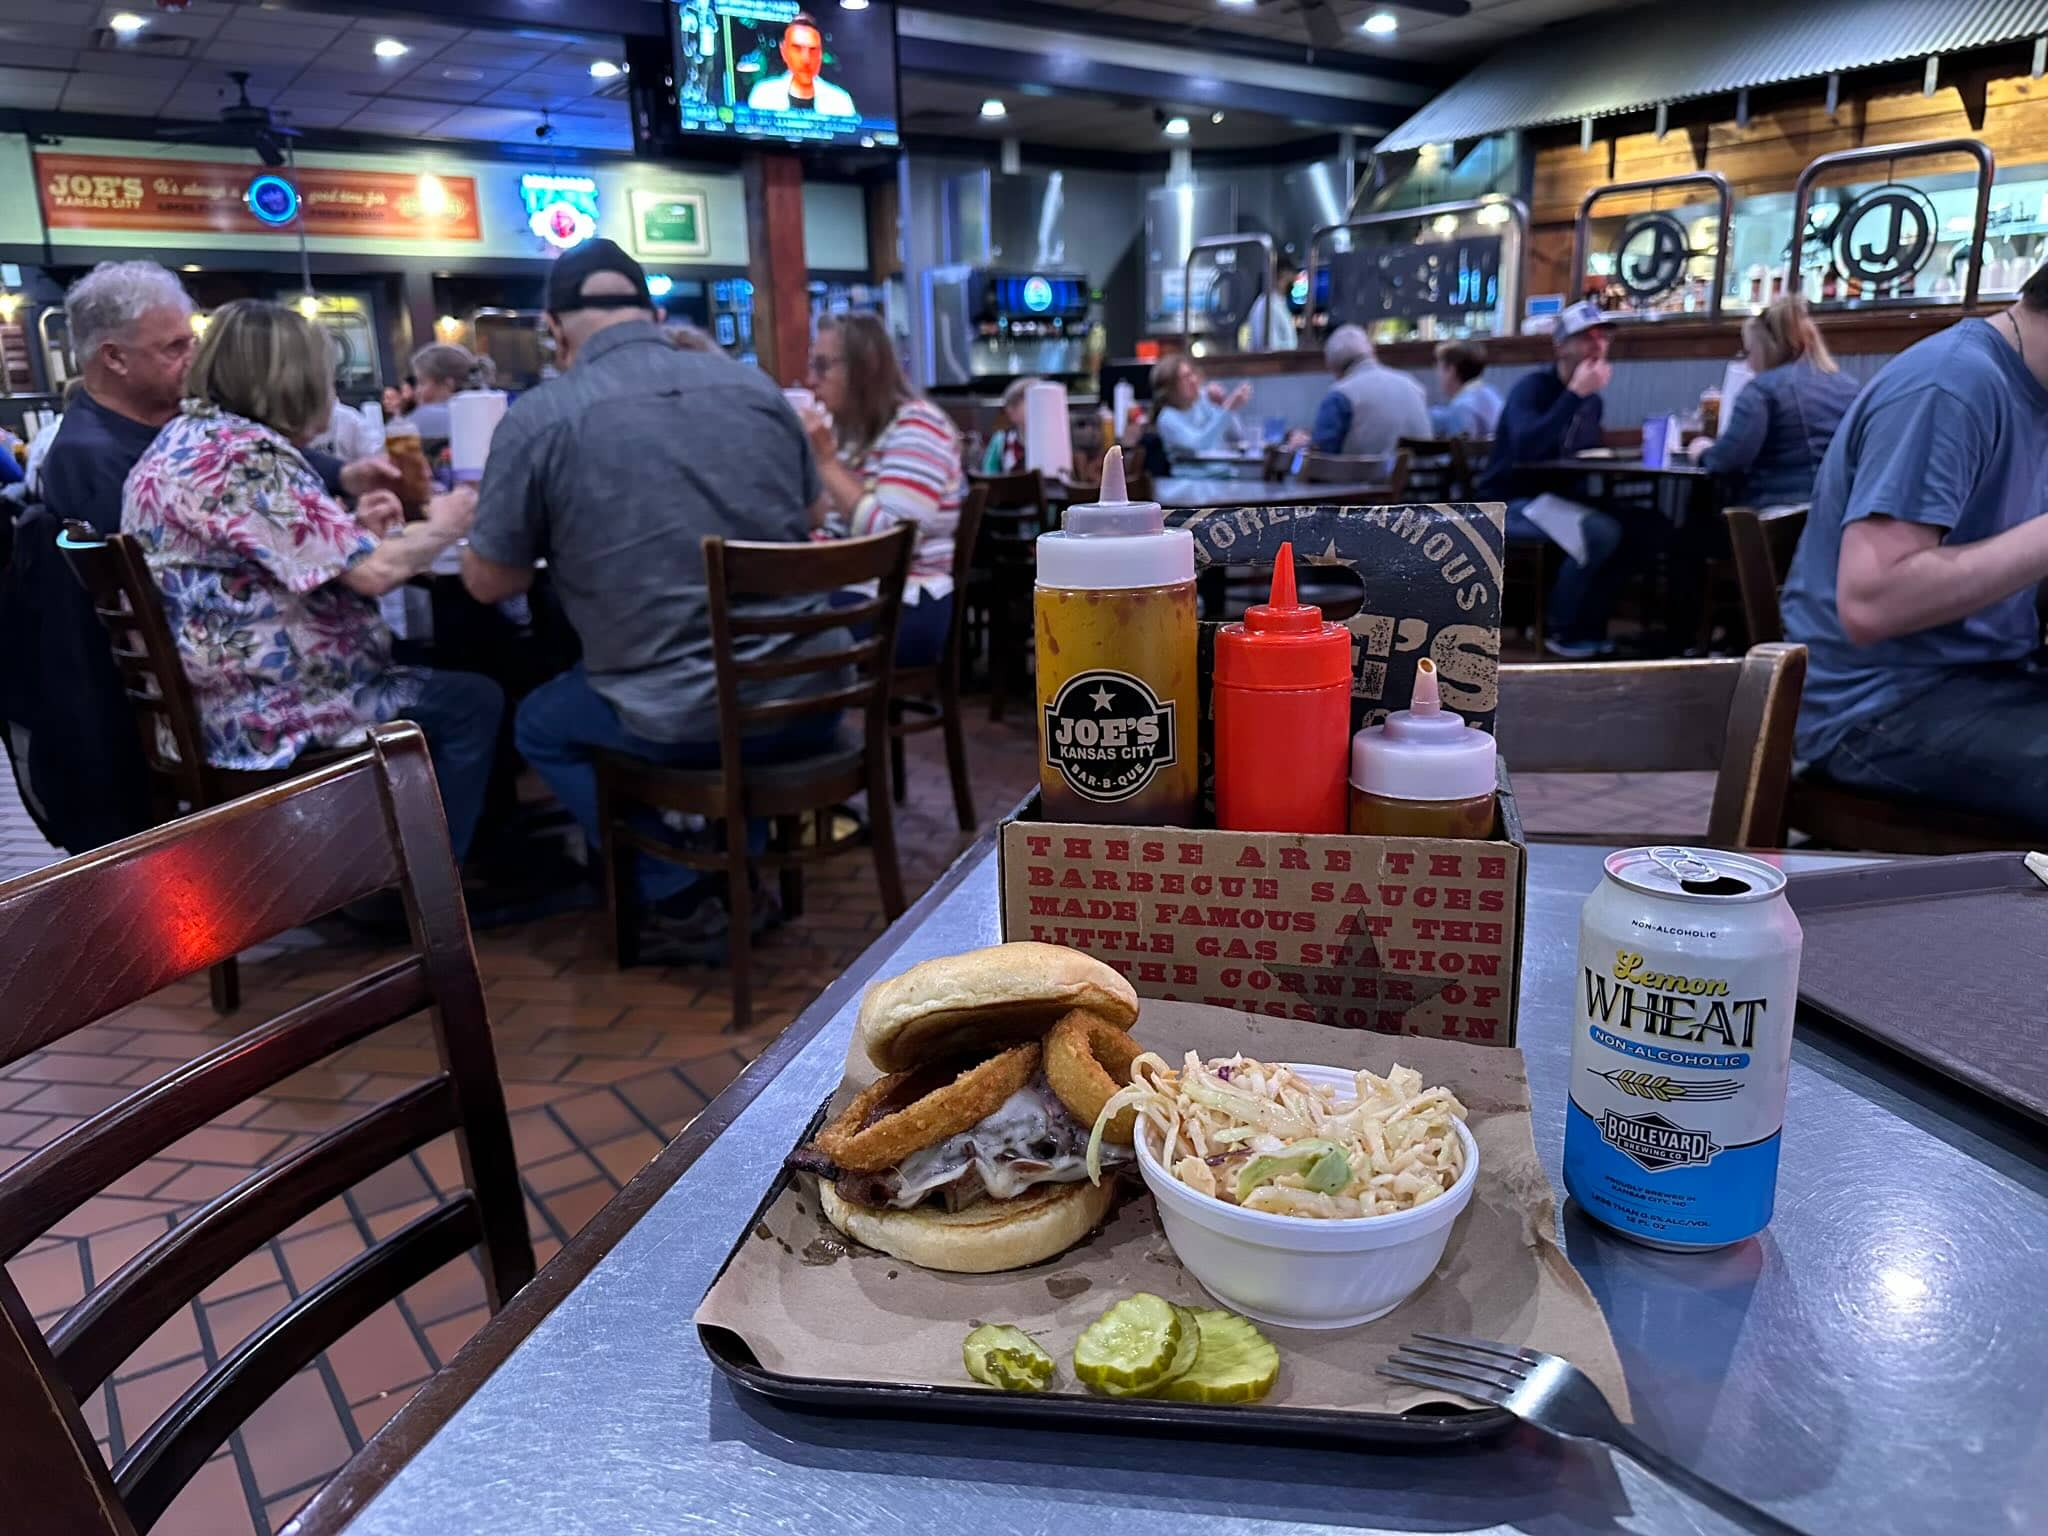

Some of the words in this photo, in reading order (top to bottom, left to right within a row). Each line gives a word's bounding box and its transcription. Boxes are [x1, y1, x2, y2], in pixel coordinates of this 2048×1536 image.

[49, 174, 144, 200] JOE'S
[55, 196, 109, 209] KANSAS
[112, 198, 141, 209] CITY
[1351, 614, 1500, 712] E'S
[1055, 715, 1160, 746] JOE'S
[1060, 745, 1117, 760] KANSAS
[1121, 744, 1156, 759] CITY
[1071, 763, 1145, 788] BAR-B-QUE
[1027, 836, 1204, 865] THESE
[1236, 846, 1351, 872] ARE
[1386, 852, 1506, 879] THE
[1027, 866, 1279, 899] BARBECUE
[1311, 881, 1504, 911] SAUCES
[1029, 896, 1137, 921] MADE
[1155, 903, 1316, 932] FAMOUS
[1335, 914, 1393, 937] AT
[1412, 918, 1503, 944] THE
[1631, 919, 1717, 939] NON-ALCOHOLIC
[1030, 925, 1174, 954] LITTLE
[1195, 937, 1278, 961] GAS
[1300, 943, 1500, 976] STATION
[1220, 968, 1415, 1002] CORNER
[1441, 984, 1500, 1007] OF
[1613, 949, 1730, 996] Lemon
[1585, 966, 1767, 1048] WHEAT
[1442, 1015, 1498, 1039] IN
[1595, 1030, 1740, 1066] NON-ALCOHOLIC
[1607, 1116, 1704, 1158] BOULEVARD
[1623, 1141, 1666, 1157] BREWING
[1669, 1152, 1684, 1161] CO.
[1605, 1175, 1643, 1193] PROUDLY
[1645, 1188, 1685, 1201] BREWED
[1611, 1184, 1647, 1200] KANSAS
[1613, 1202, 1639, 1217] THAN
